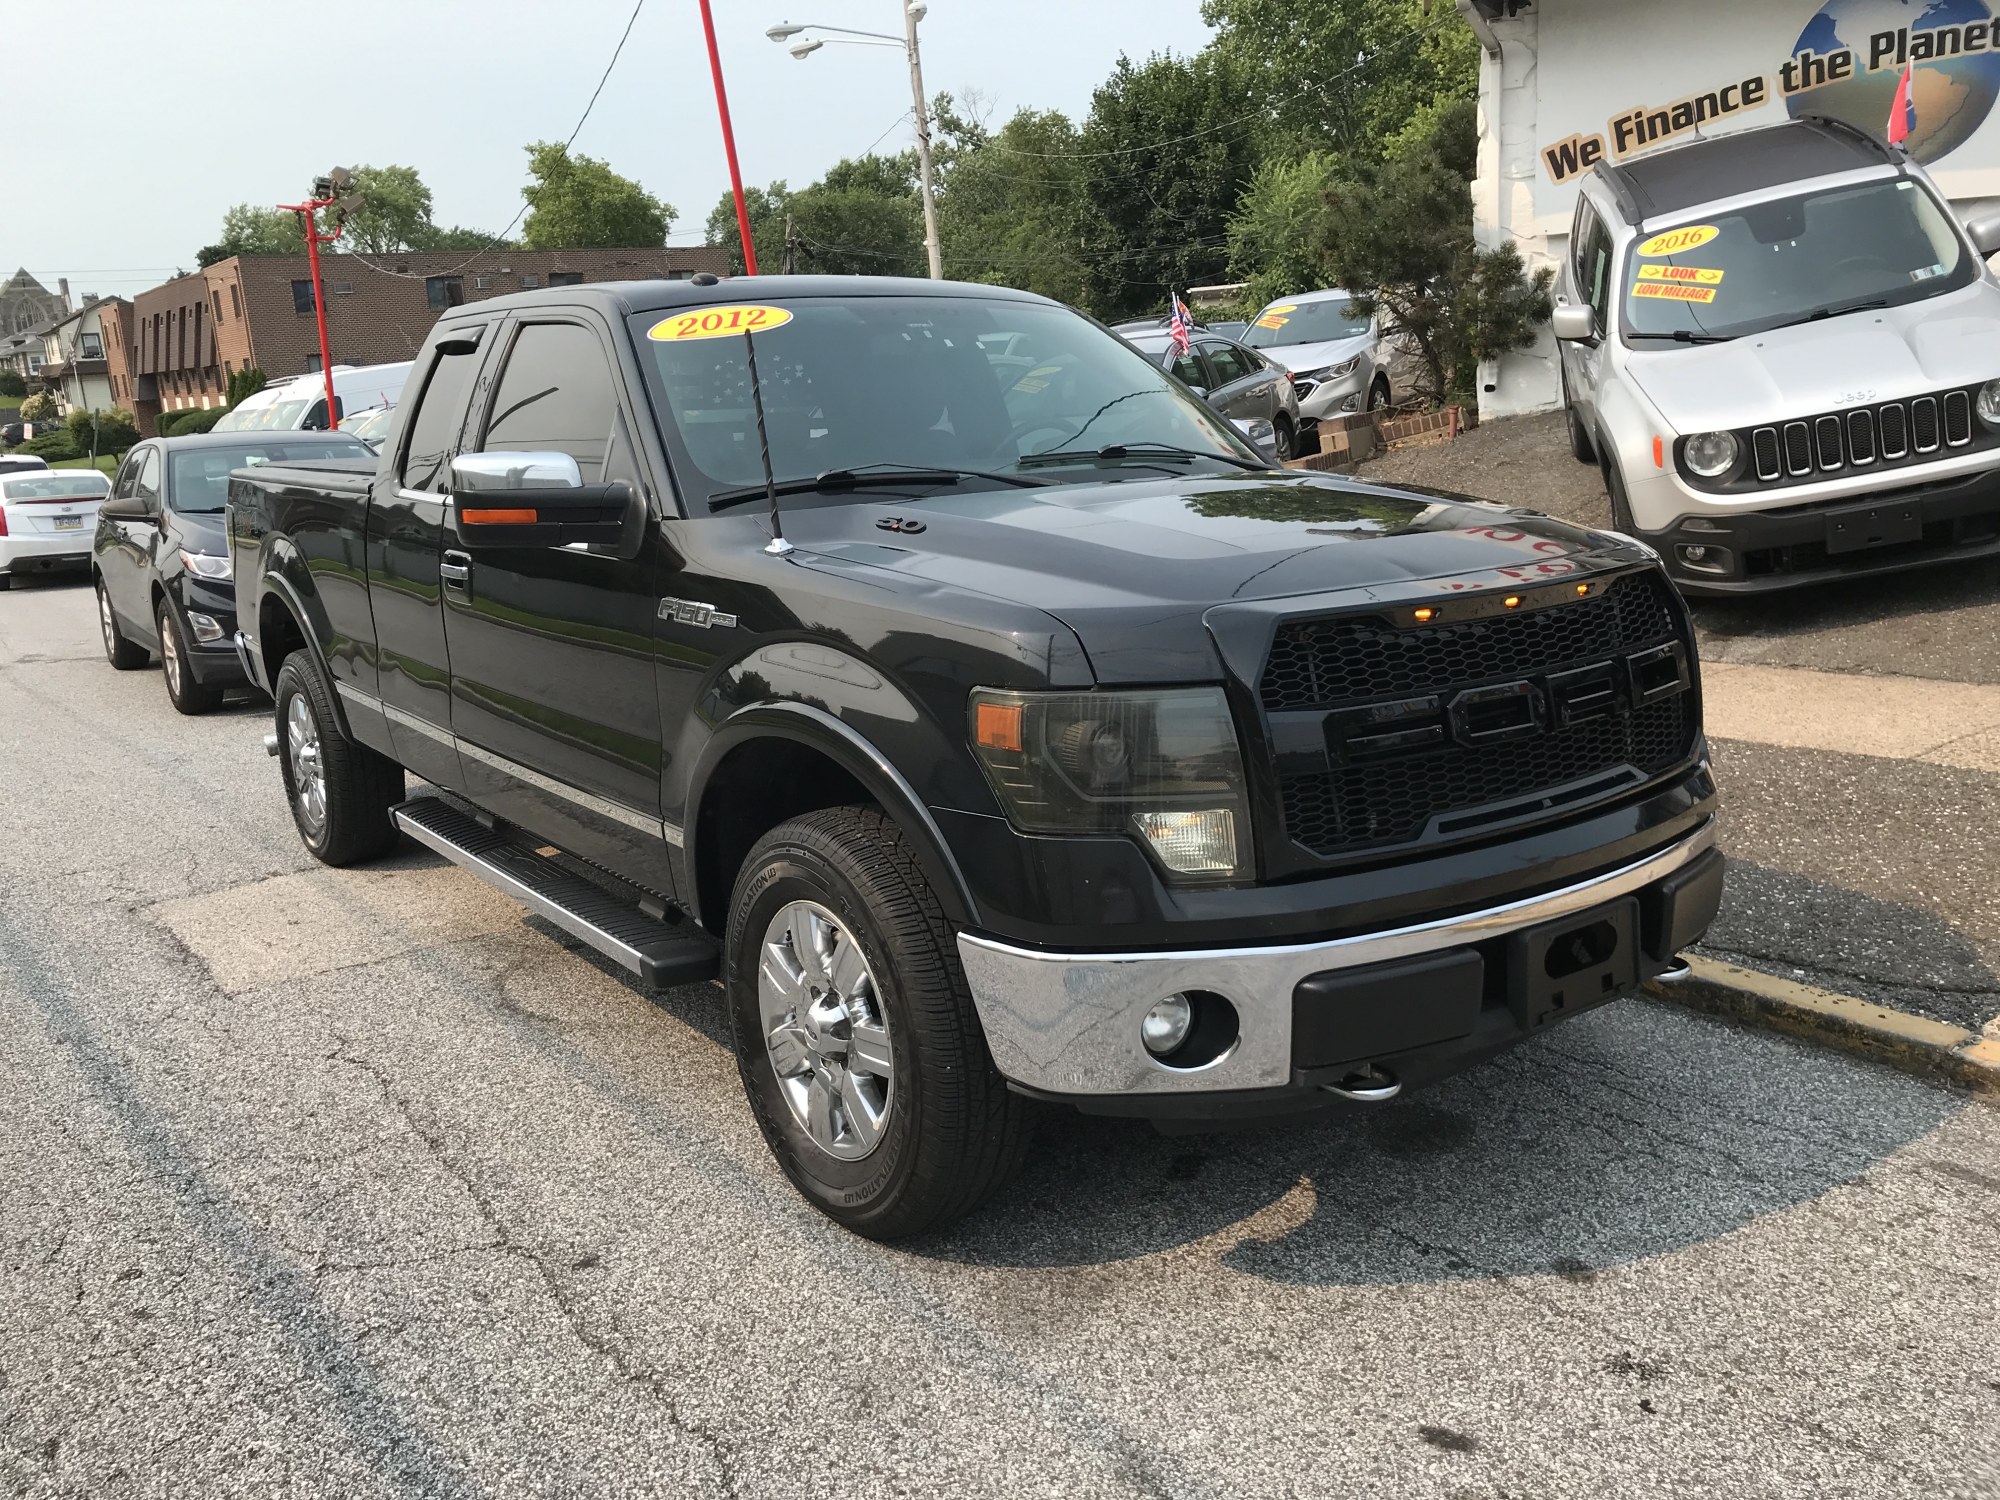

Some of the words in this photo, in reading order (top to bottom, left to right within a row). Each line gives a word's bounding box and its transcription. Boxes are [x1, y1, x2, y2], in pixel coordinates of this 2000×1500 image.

[1546, 138, 1601, 180] We
[1613, 76, 1764, 153] Finance
[1779, 50, 1851, 93] the
[1869, 16, 2000, 70] Planet
[1652, 227, 1705, 254] 2016
[1662, 267, 1701, 280] LOOK
[1636, 283, 1662, 296] LOW
[1661, 285, 1712, 300] MILEAGE
[677, 309, 767, 336] 2012
[1833, 388, 1877, 405] Jeep
[1322, 639, 1691, 770] FORD
